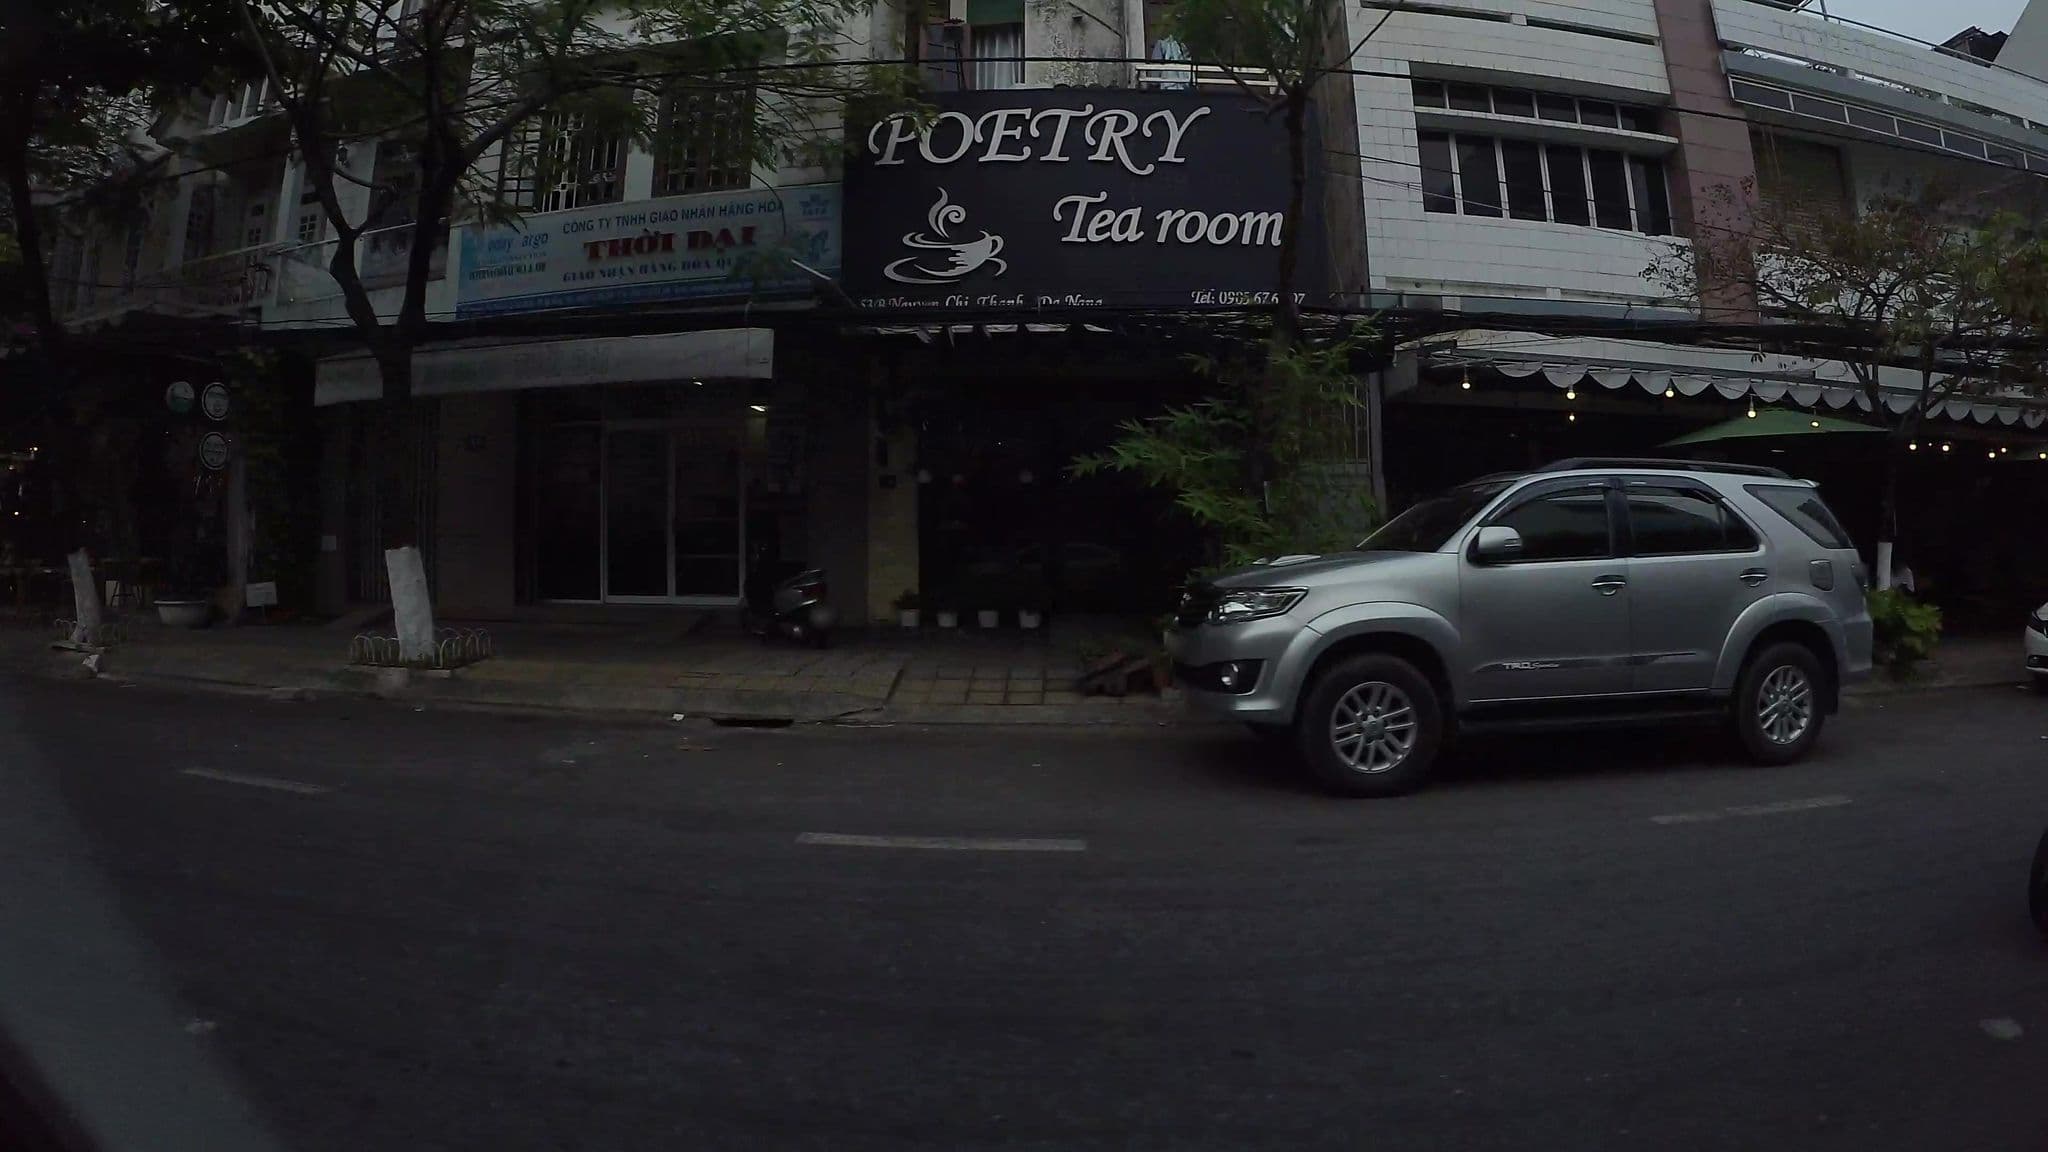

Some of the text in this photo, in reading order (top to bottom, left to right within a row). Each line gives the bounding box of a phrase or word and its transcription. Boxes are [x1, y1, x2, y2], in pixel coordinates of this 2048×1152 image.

[868, 103, 1212, 176] POETRY
[598, 216, 611, 229] TY
[616, 213, 647, 227] TNHH
[649, 209, 679, 224] GIAO
[1052, 190, 1285, 247] Tea room
[1191, 288, 1216, 305] Tel:
